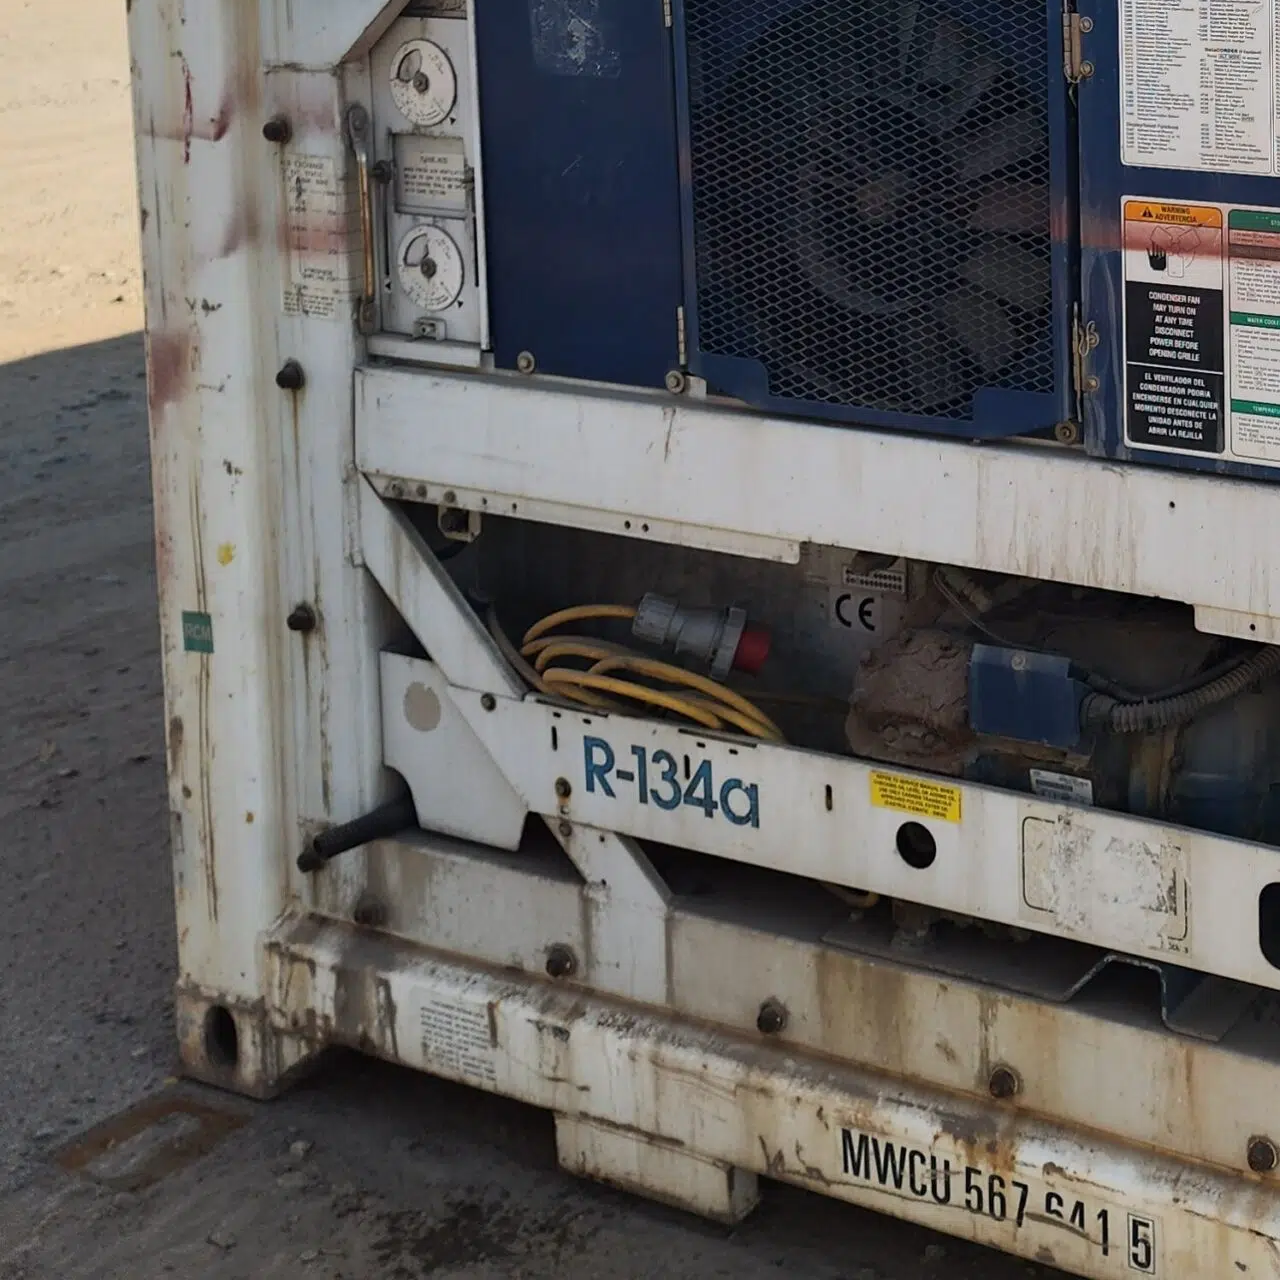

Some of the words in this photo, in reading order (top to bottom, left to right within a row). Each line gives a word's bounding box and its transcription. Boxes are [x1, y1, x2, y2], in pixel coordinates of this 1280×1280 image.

[1160, 206, 1191, 216] WARNING
[1155, 214, 1197, 224] ADVERTENCIA
[1149, 291, 1186, 303] CONDENSER
[1187, 295, 1200, 304] FAN
[1153, 303, 1167, 312] MAY
[1168, 304, 1185, 314] TURN
[1186, 306, 1196, 315] ON
[1155, 315, 1163, 323] AT
[1163, 316, 1177, 324] ANY
[1178, 317, 1193, 326] TIME
[1154, 326, 1194, 338] DISCONNECT
[1150, 337, 1173, 347] POWER
[1174, 339, 1199, 350] BEFORE
[1149, 348, 1176, 359] OPENING
[1177, 351, 1200, 361] GRILLE
[1153, 373, 1191, 385] VENTILADOR
[1193, 379, 1205, 387] DEL
[1139, 383, 1186, 395] CONDENSADOR
[1187, 388, 1211, 398] PODRIA
[1132, 392, 1172, 404] ENCENDERSE
[1173, 397, 1182, 405] EN
[1183, 398, 1218, 409] CUALQUIER
[1134, 403, 1166, 414] MOMENTO
[1167, 408, 1207, 419] DESCONECTE
[1208, 412, 1216, 420] LA
[1148, 416, 1172, 425] UNIDAD
[1173, 419, 1192, 428] ANTES
[1194, 421, 1203, 429] DE
[1148, 426, 1167, 436] ABRIR
[1168, 429, 1177, 437] LA
[1178, 430, 1203, 440] REJILLA
[834, 593, 875, 631] CE
[584, 734, 761, 829] R-134a
[841, 1128, 951, 1205] MWCU
[964, 1166, 1029, 1228] 567
[1131, 1219, 1152, 1270] 5
